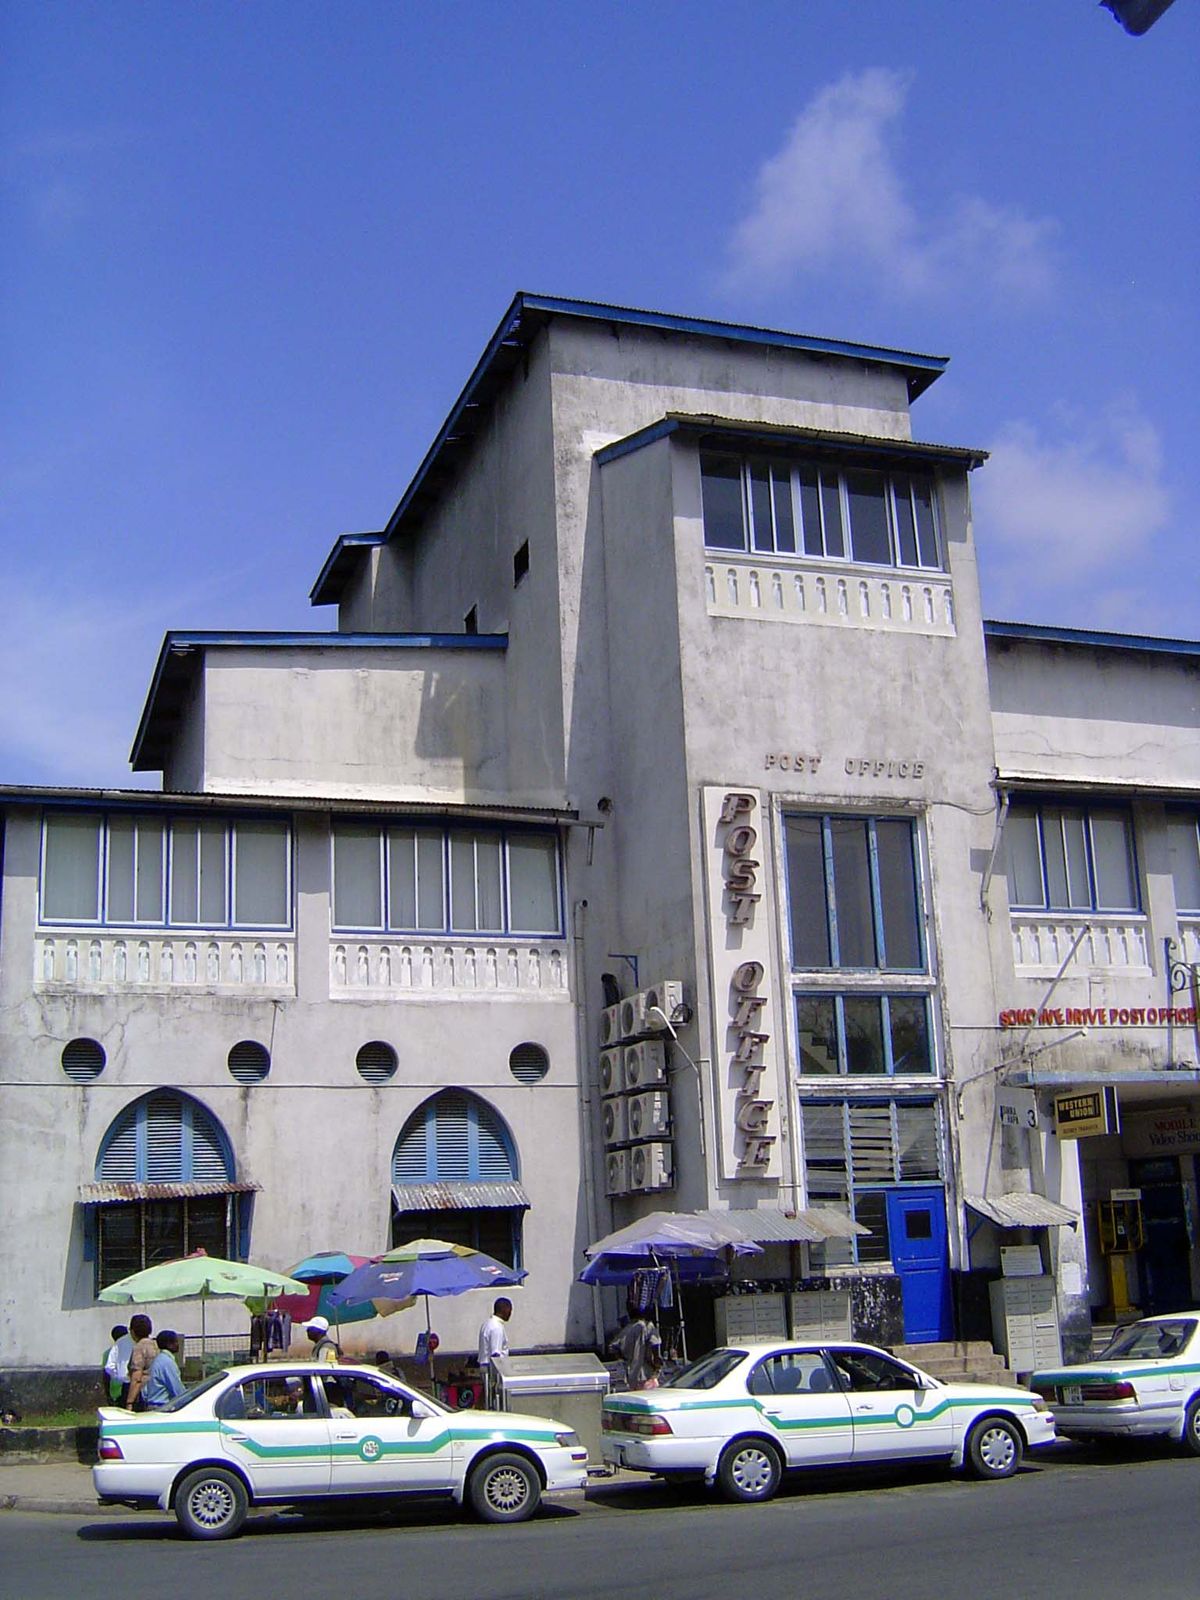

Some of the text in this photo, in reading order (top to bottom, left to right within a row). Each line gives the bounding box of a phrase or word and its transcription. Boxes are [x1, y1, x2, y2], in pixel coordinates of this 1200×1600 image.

[764, 753, 925, 779] POST OFFICE
[719, 793, 777, 1168] POST OFFICE
[1065, 1007, 1107, 1026] DRIVE
[1109, 1008, 1146, 1026] POST
[1058, 1096, 1095, 1111] WESTERN
[1069, 1106, 1094, 1118] UNION
[1027, 1109, 1036, 1128] 3
